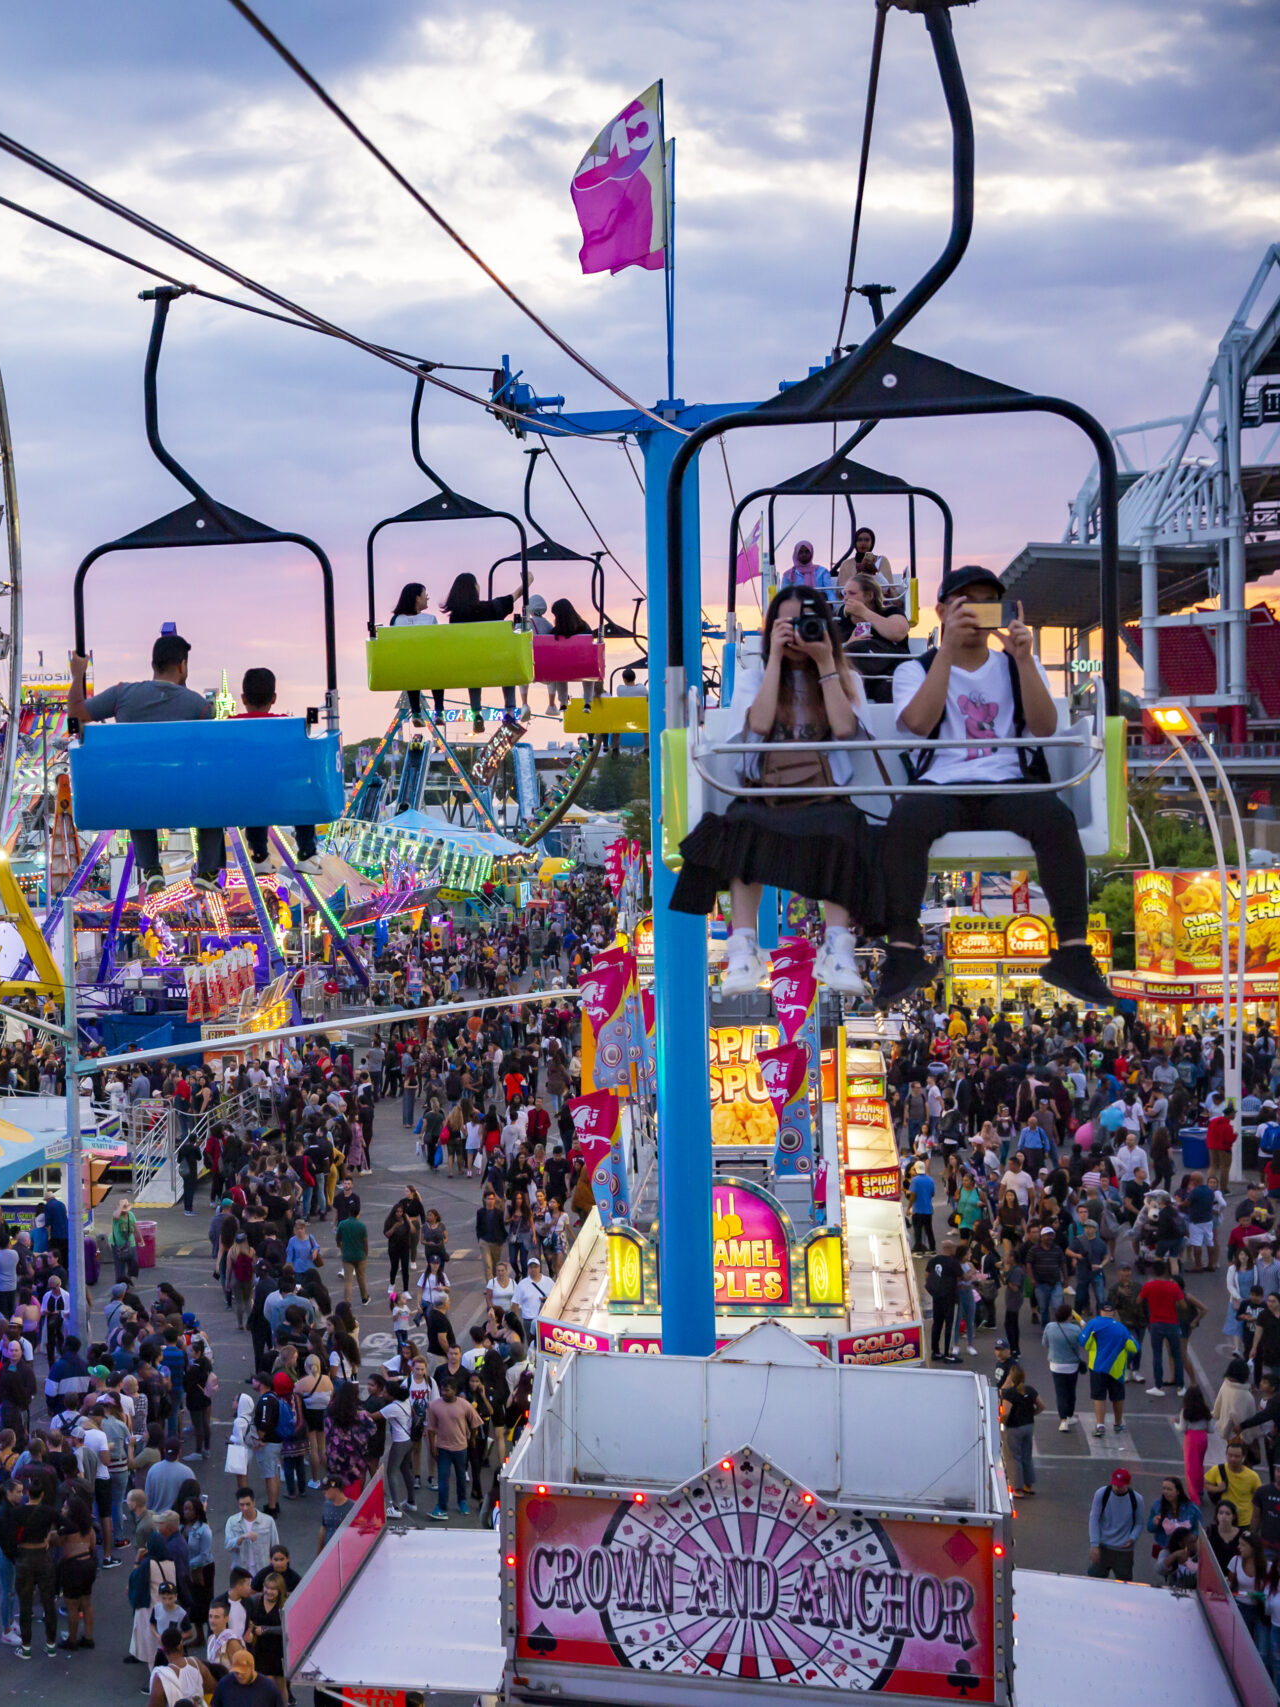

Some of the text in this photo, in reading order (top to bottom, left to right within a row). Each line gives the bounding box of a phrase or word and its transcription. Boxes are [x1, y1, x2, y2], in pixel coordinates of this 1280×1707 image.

[1136, 873, 1172, 897] WINGS
[1142, 898, 1168, 916] FRIES
[955, 921, 1002, 930] COFFEE
[1010, 941, 1046, 951] COFFEE
[1146, 983, 1191, 995] NACHOS
[861, 1174, 897, 1187] SPIRAL
[862, 1184, 896, 1198] SPUDS
[714, 1239, 780, 1268] AMEL
[714, 1271, 783, 1299] PLES
[552, 1327, 597, 1351] COLD
[853, 1332, 905, 1353] COLD
[843, 1343, 915, 1366] DRINKS
[527, 1533, 978, 1651] CROWN AND ANCHOR
